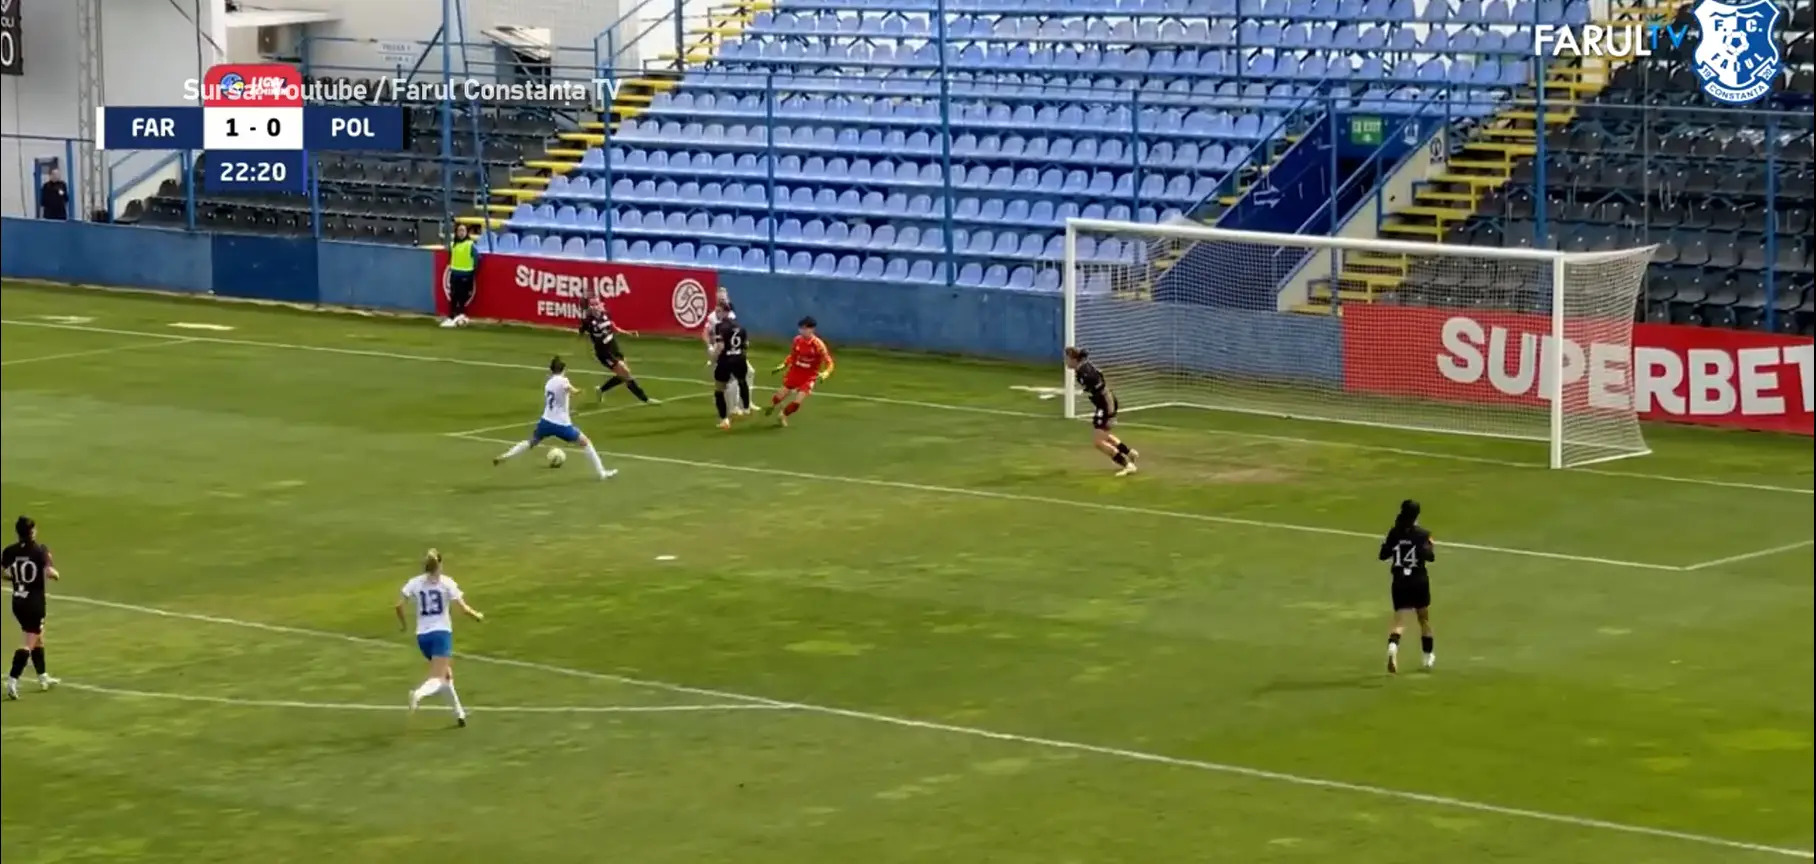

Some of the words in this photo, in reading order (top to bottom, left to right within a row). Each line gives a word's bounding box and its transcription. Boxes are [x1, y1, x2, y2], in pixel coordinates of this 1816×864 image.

[515, 264, 631, 299] SUPERLIGA
[537, 300, 589, 319] FEMIN
[730, 327, 742, 347] 6
[1437, 317, 1815, 416] SUPERBET
[1392, 544, 1419, 568] 14
[12, 559, 38, 583] 10
[419, 590, 444, 616] 13
